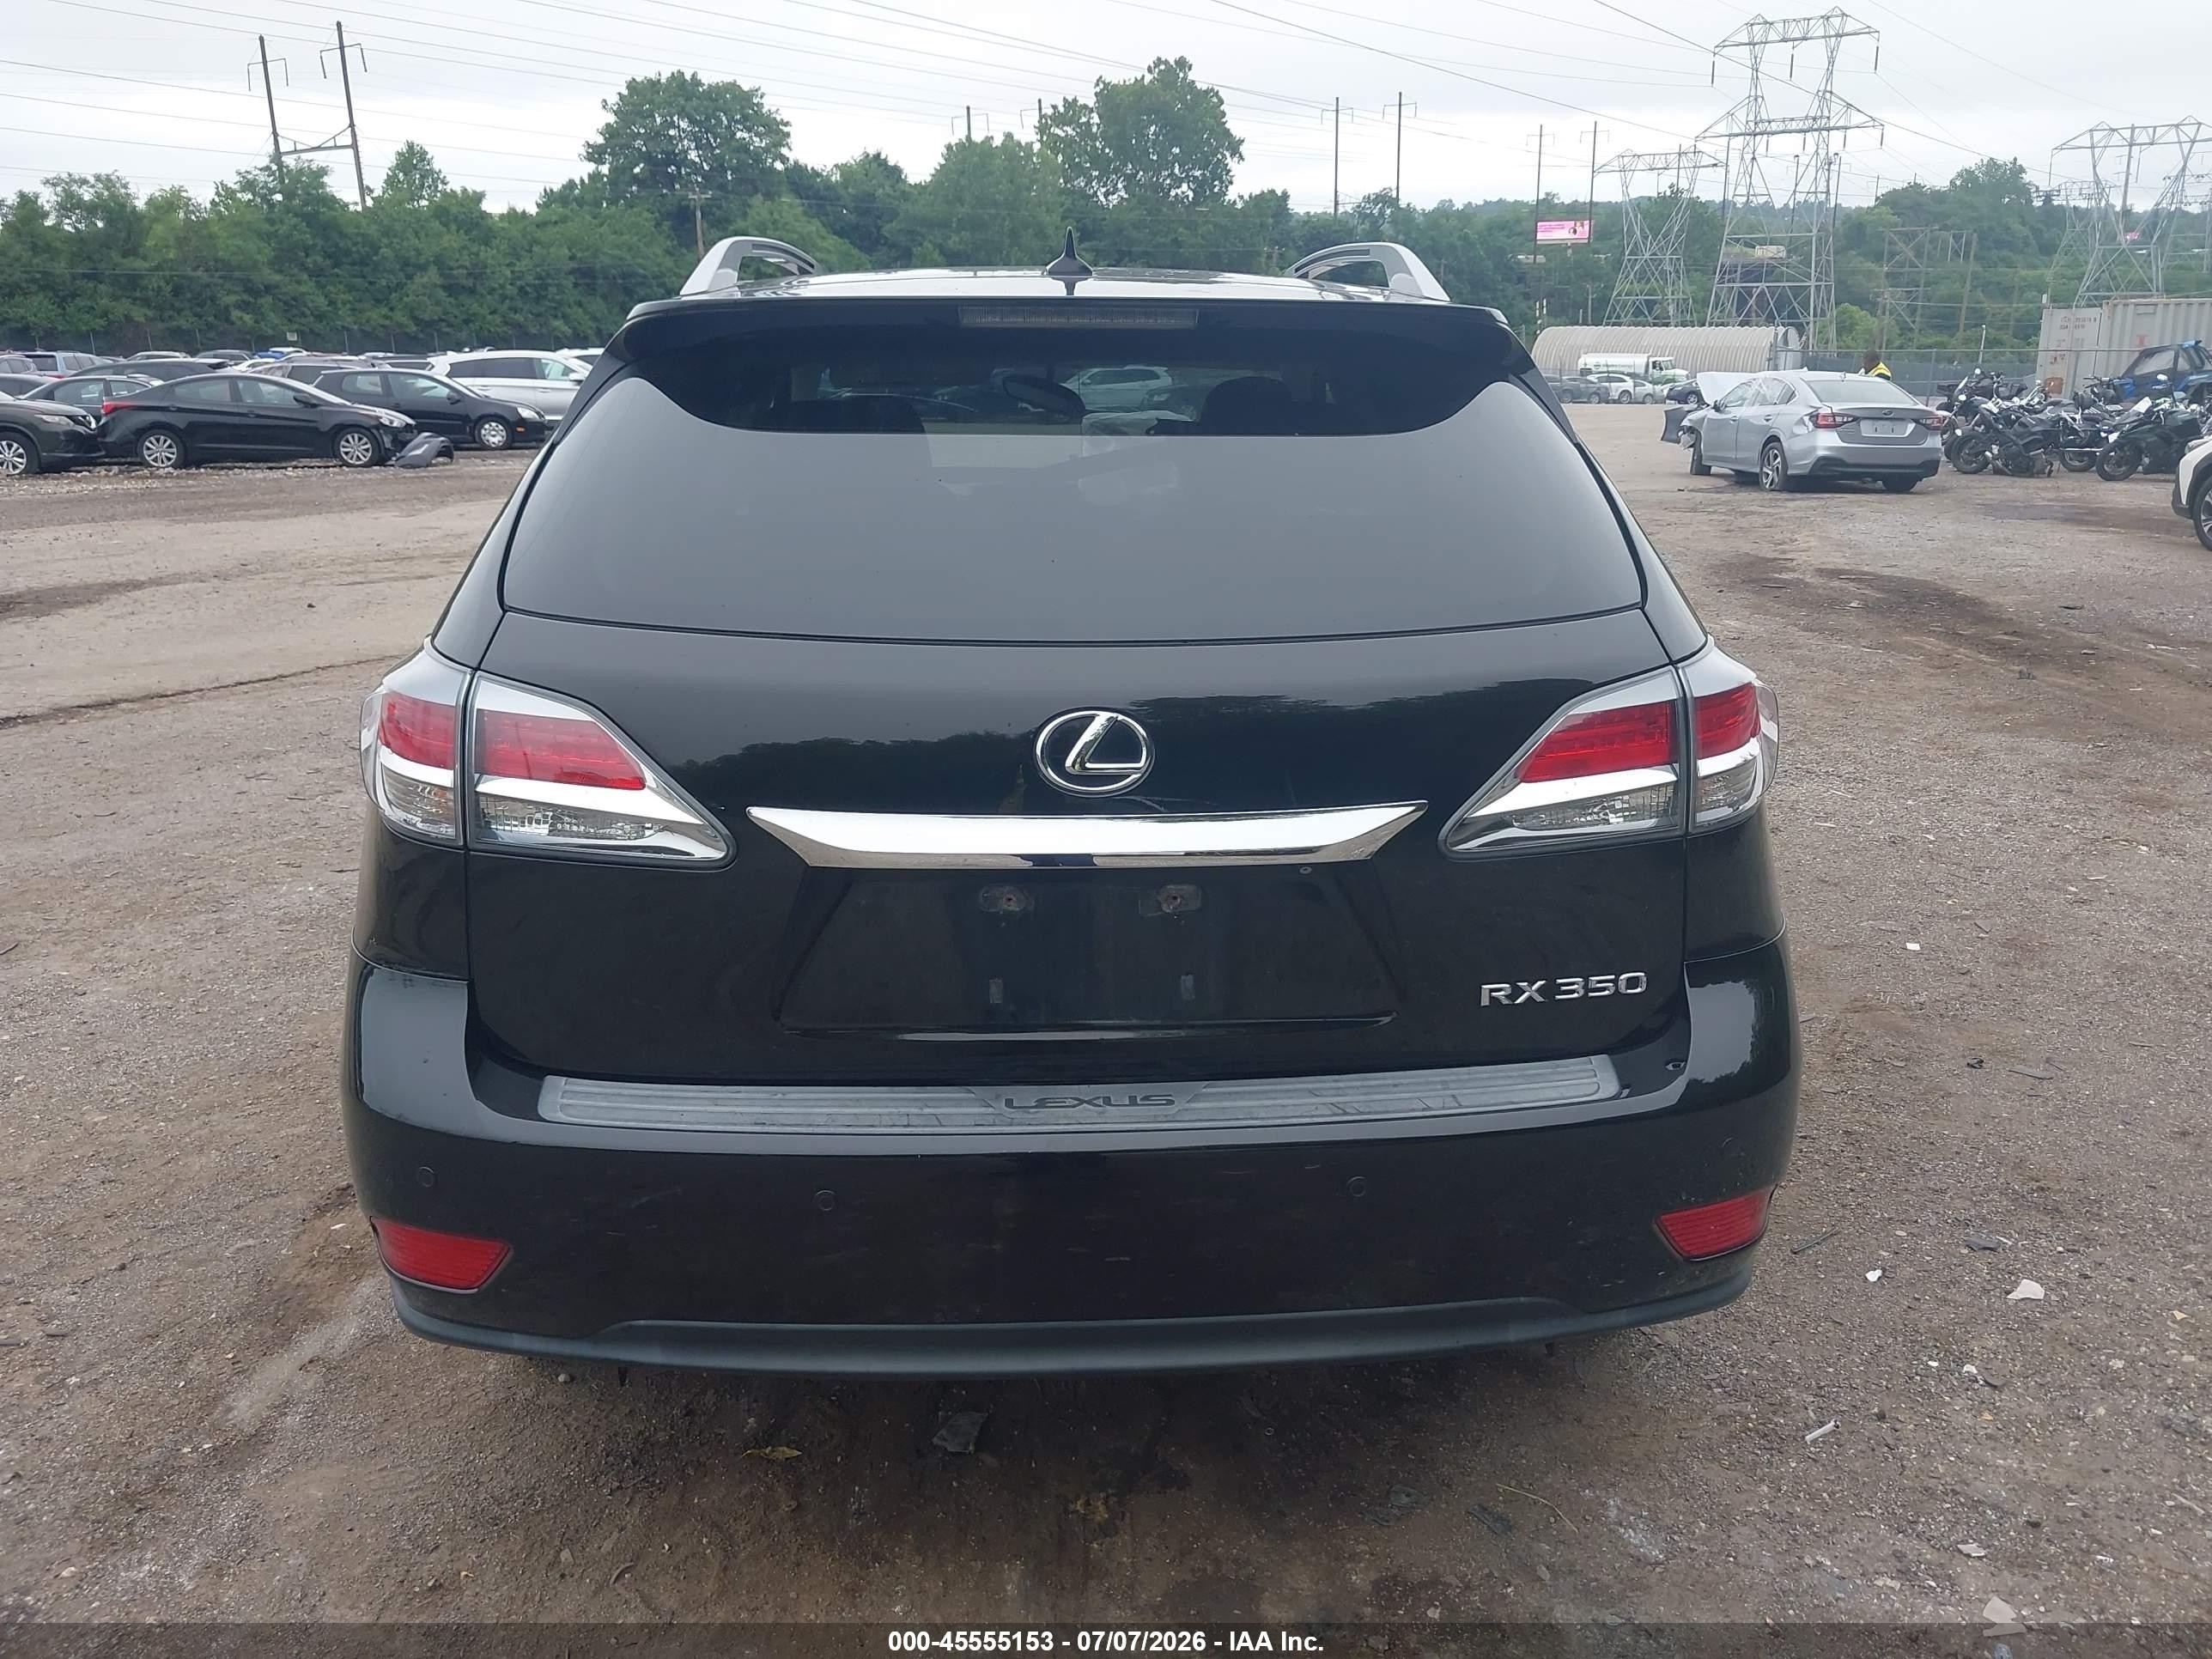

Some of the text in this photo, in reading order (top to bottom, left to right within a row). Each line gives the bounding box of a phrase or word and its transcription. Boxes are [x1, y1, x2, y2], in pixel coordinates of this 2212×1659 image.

[1480, 971, 1647, 1006] RX 350
[1004, 1093, 1176, 1109] LEXUS
